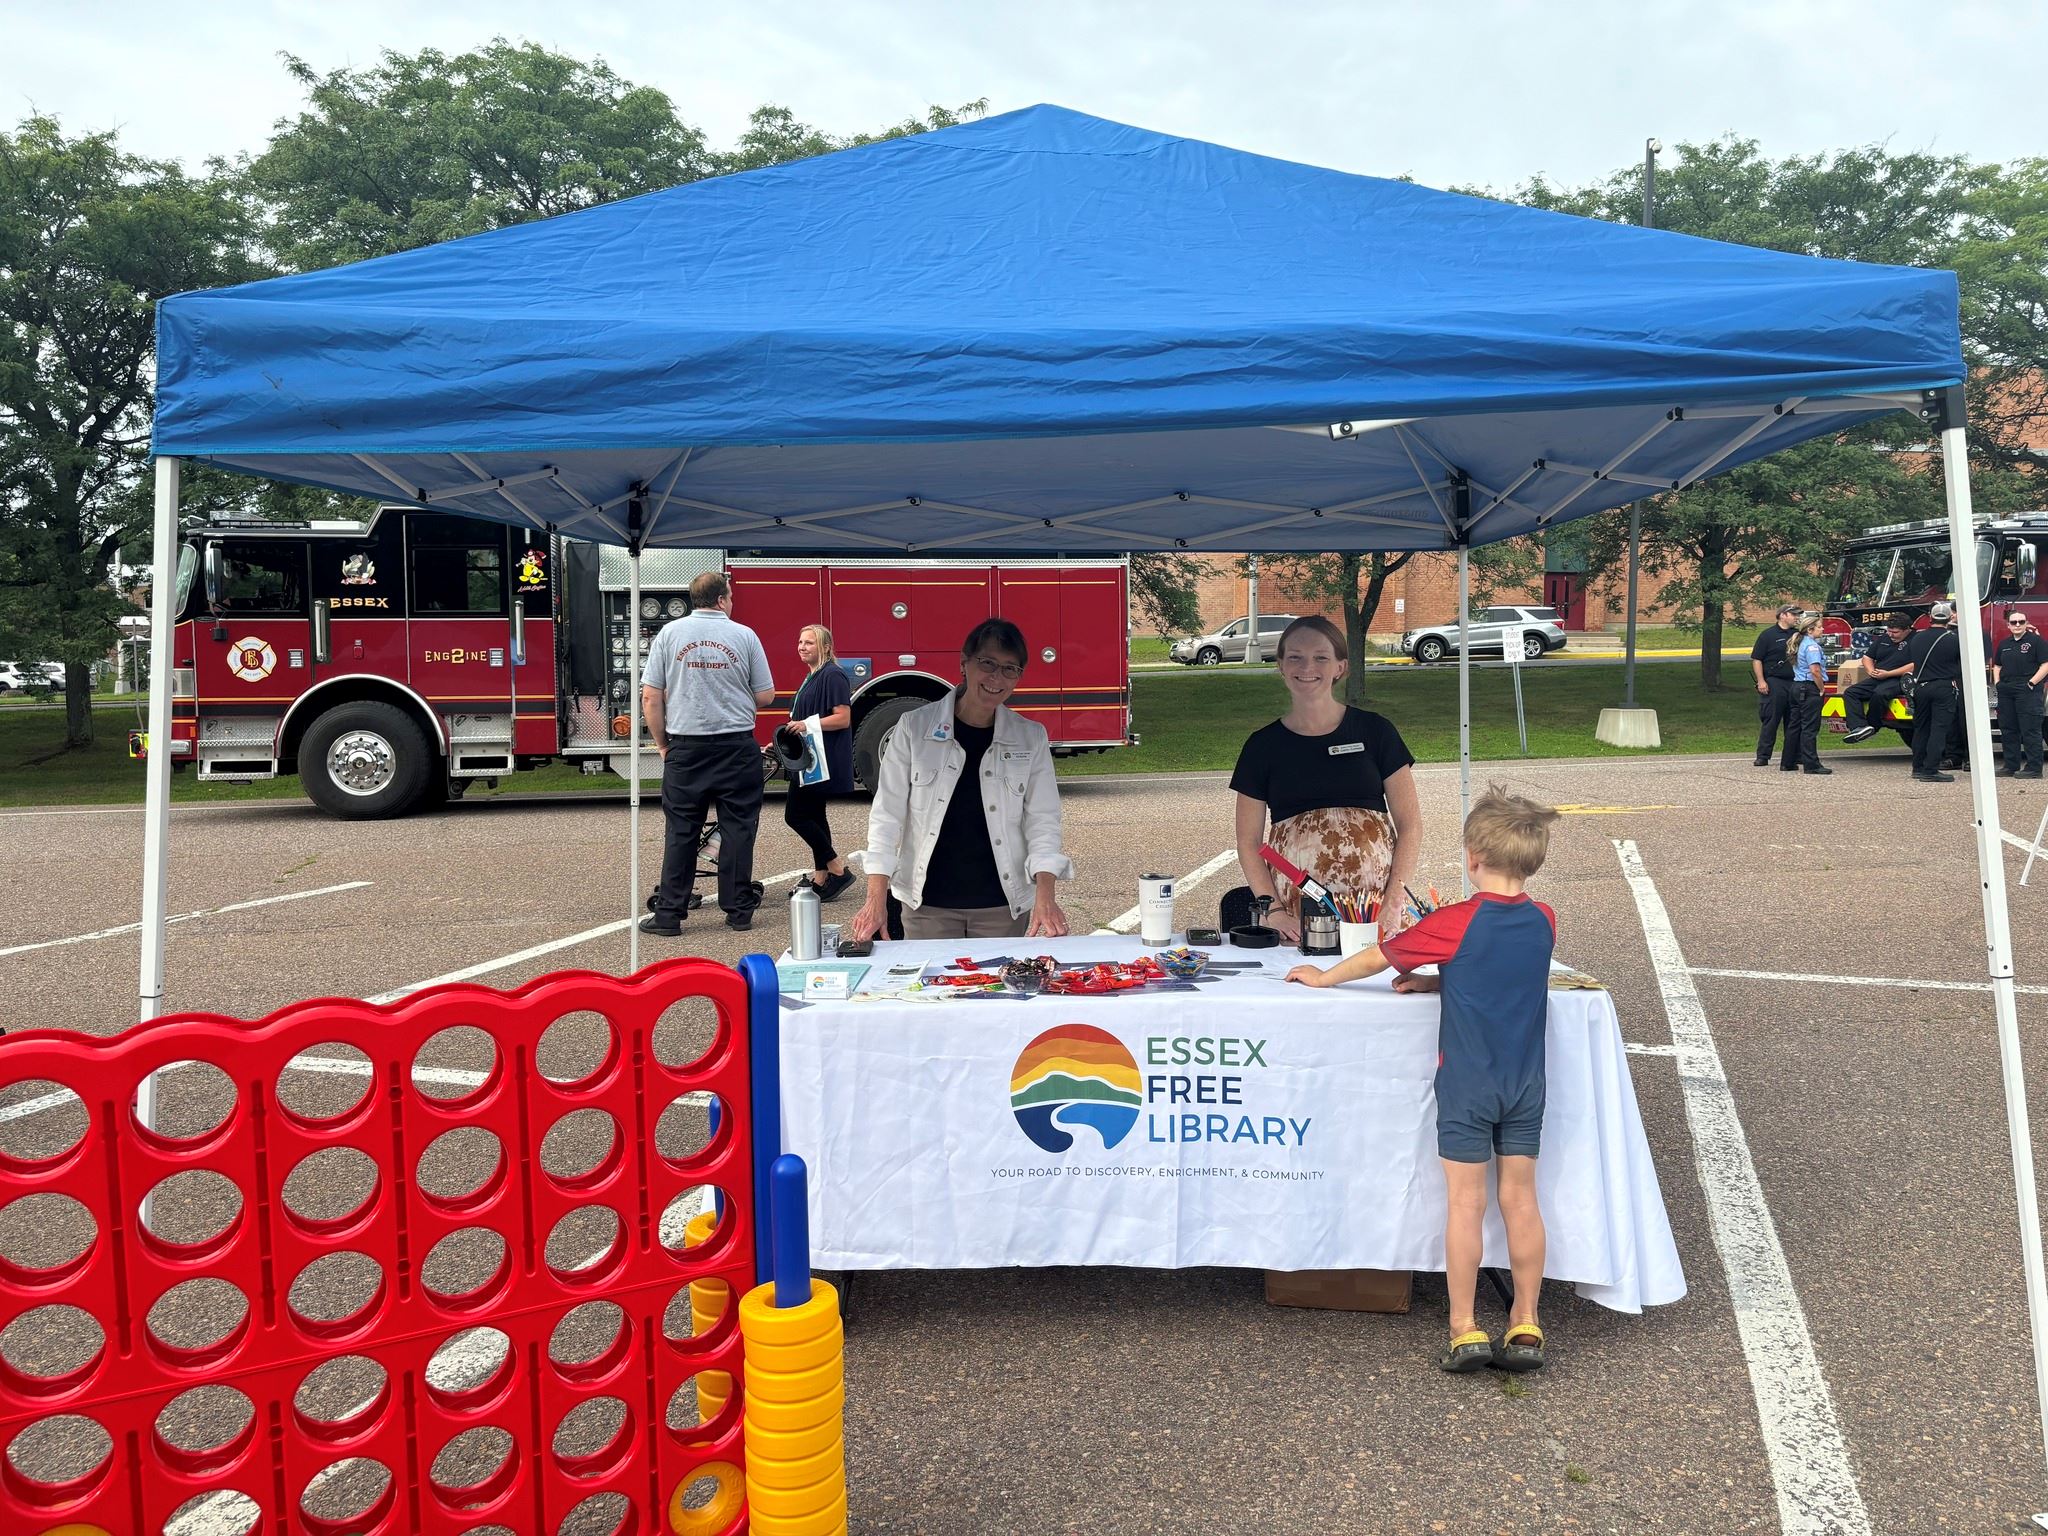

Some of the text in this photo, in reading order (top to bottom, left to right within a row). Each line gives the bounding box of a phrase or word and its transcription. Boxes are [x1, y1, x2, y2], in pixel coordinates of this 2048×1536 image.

[329, 597, 389, 609] ESSEX
[1861, 612, 1896, 624] ESSE
[676, 640, 739, 664] ESSEX JUNCTION
[687, 661, 730, 670] FIRE DEPT.
[1147, 1037, 1268, 1068] ESSEX
[1147, 1075, 1243, 1105] FREE
[1147, 1113, 1312, 1147] LIBRARY
[990, 1166, 1325, 1180] YOUR ROAD TO DISCOVERY, ENRICHMENT, & COMMUNITY
